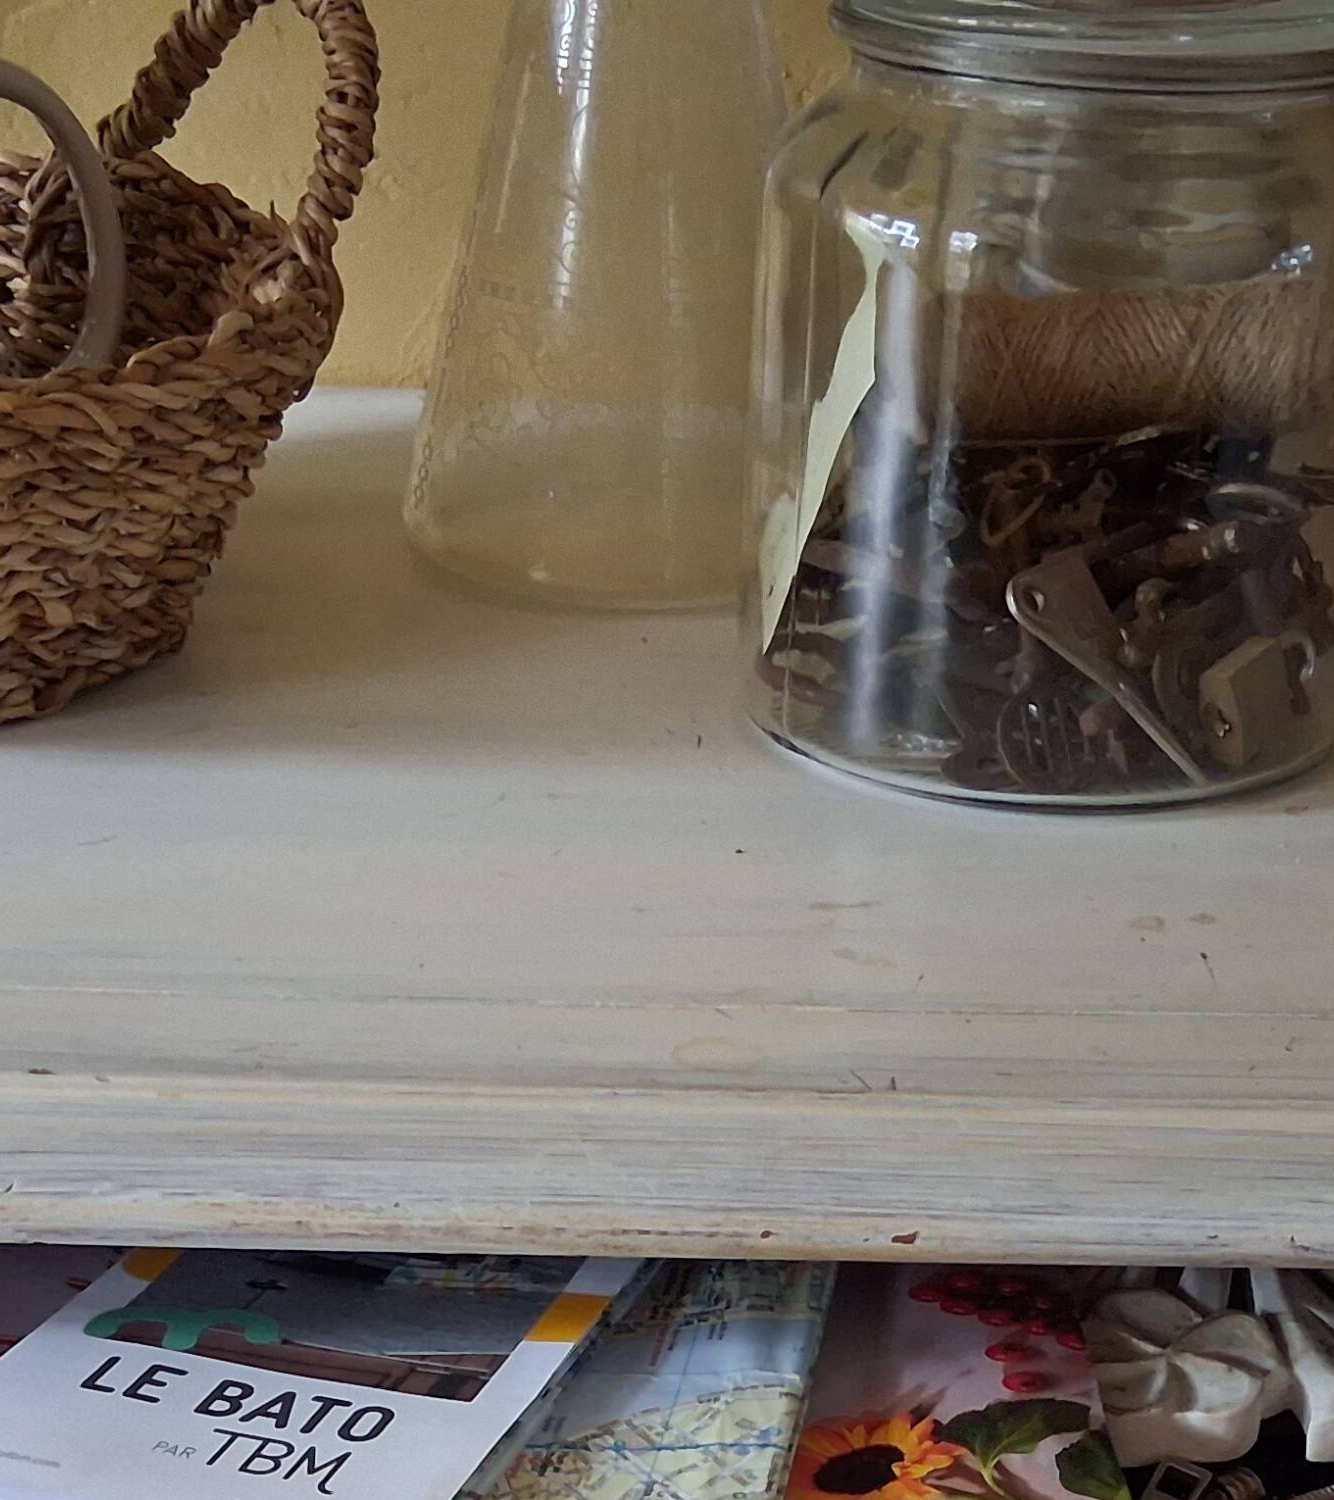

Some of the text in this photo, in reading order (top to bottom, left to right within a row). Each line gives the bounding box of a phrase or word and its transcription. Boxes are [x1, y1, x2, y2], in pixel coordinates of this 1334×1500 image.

[80, 1356, 189, 1404] LE
[193, 1379, 395, 1442] BATO
[151, 1428, 353, 1495] PAR TBM
